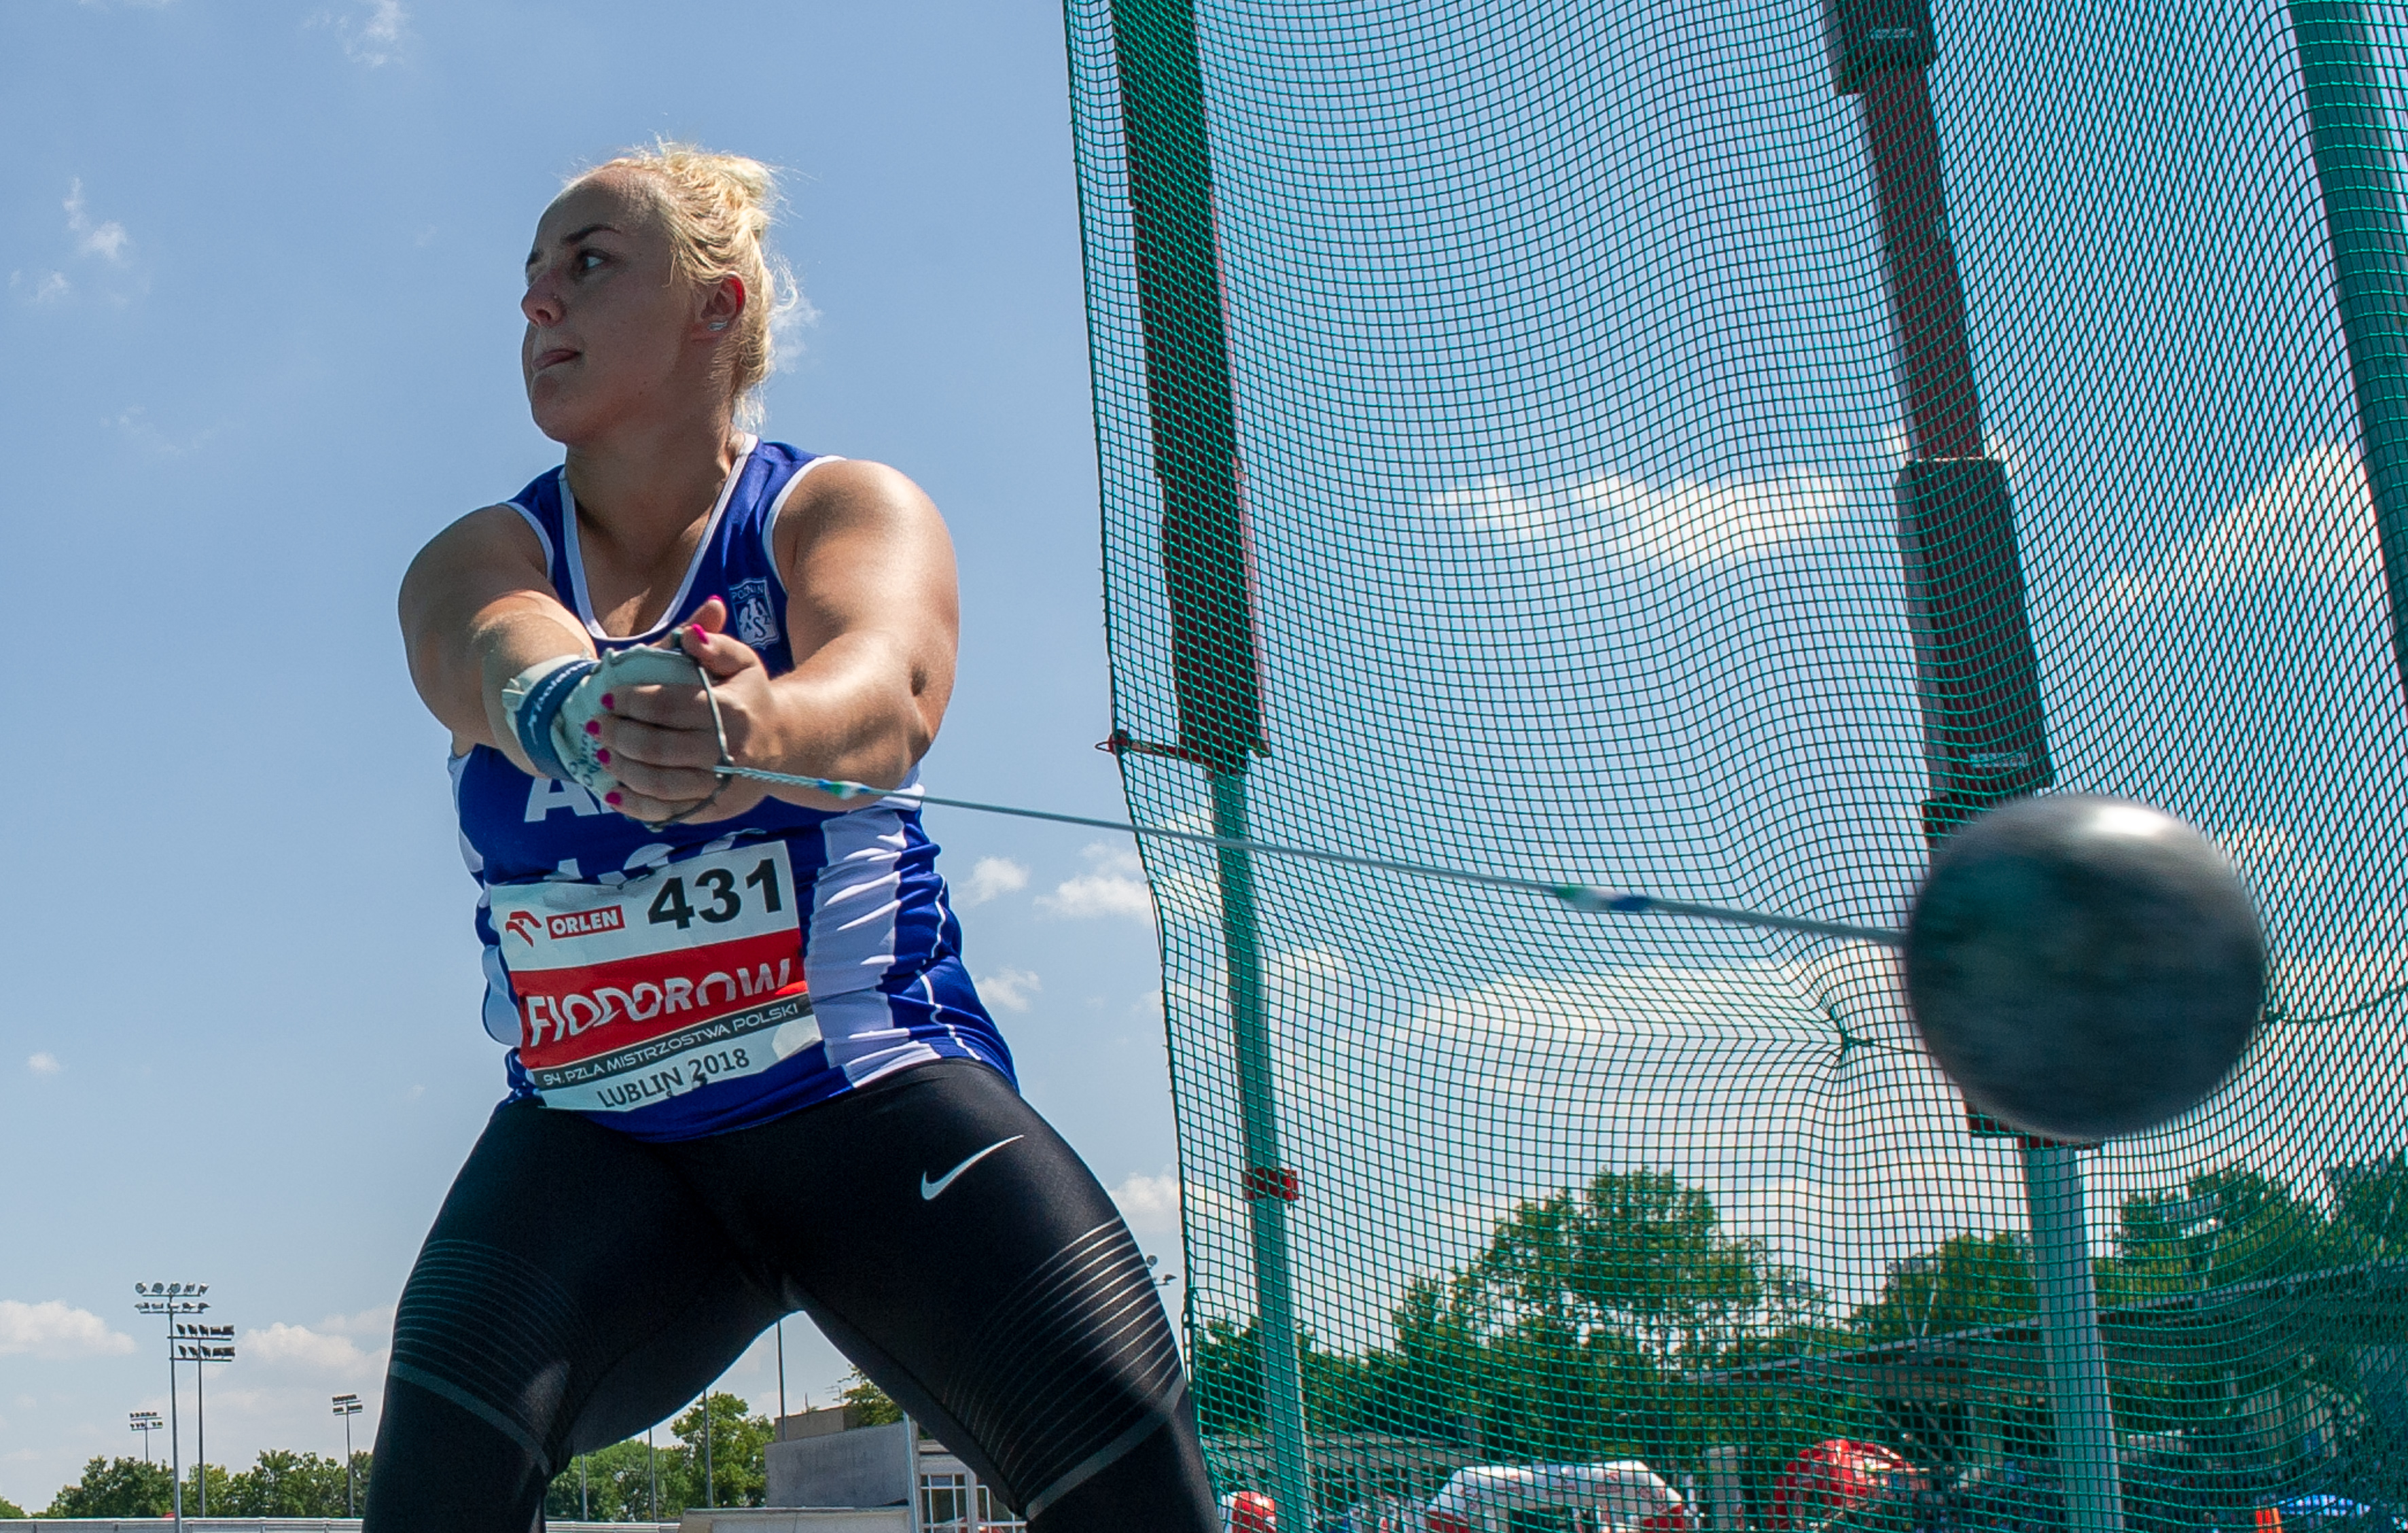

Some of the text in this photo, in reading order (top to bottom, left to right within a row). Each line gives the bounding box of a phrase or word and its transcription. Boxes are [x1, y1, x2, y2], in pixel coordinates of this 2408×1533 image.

[551, 909, 619, 935] ORLEN
[647, 858, 782, 930] 431
[526, 957, 790, 1047] FIODOROW
[544, 1002, 798, 1087] 94. PZLA MISTRZOSTWA POLSKI
[597, 1047, 750, 1108] LUBLIN 2018
